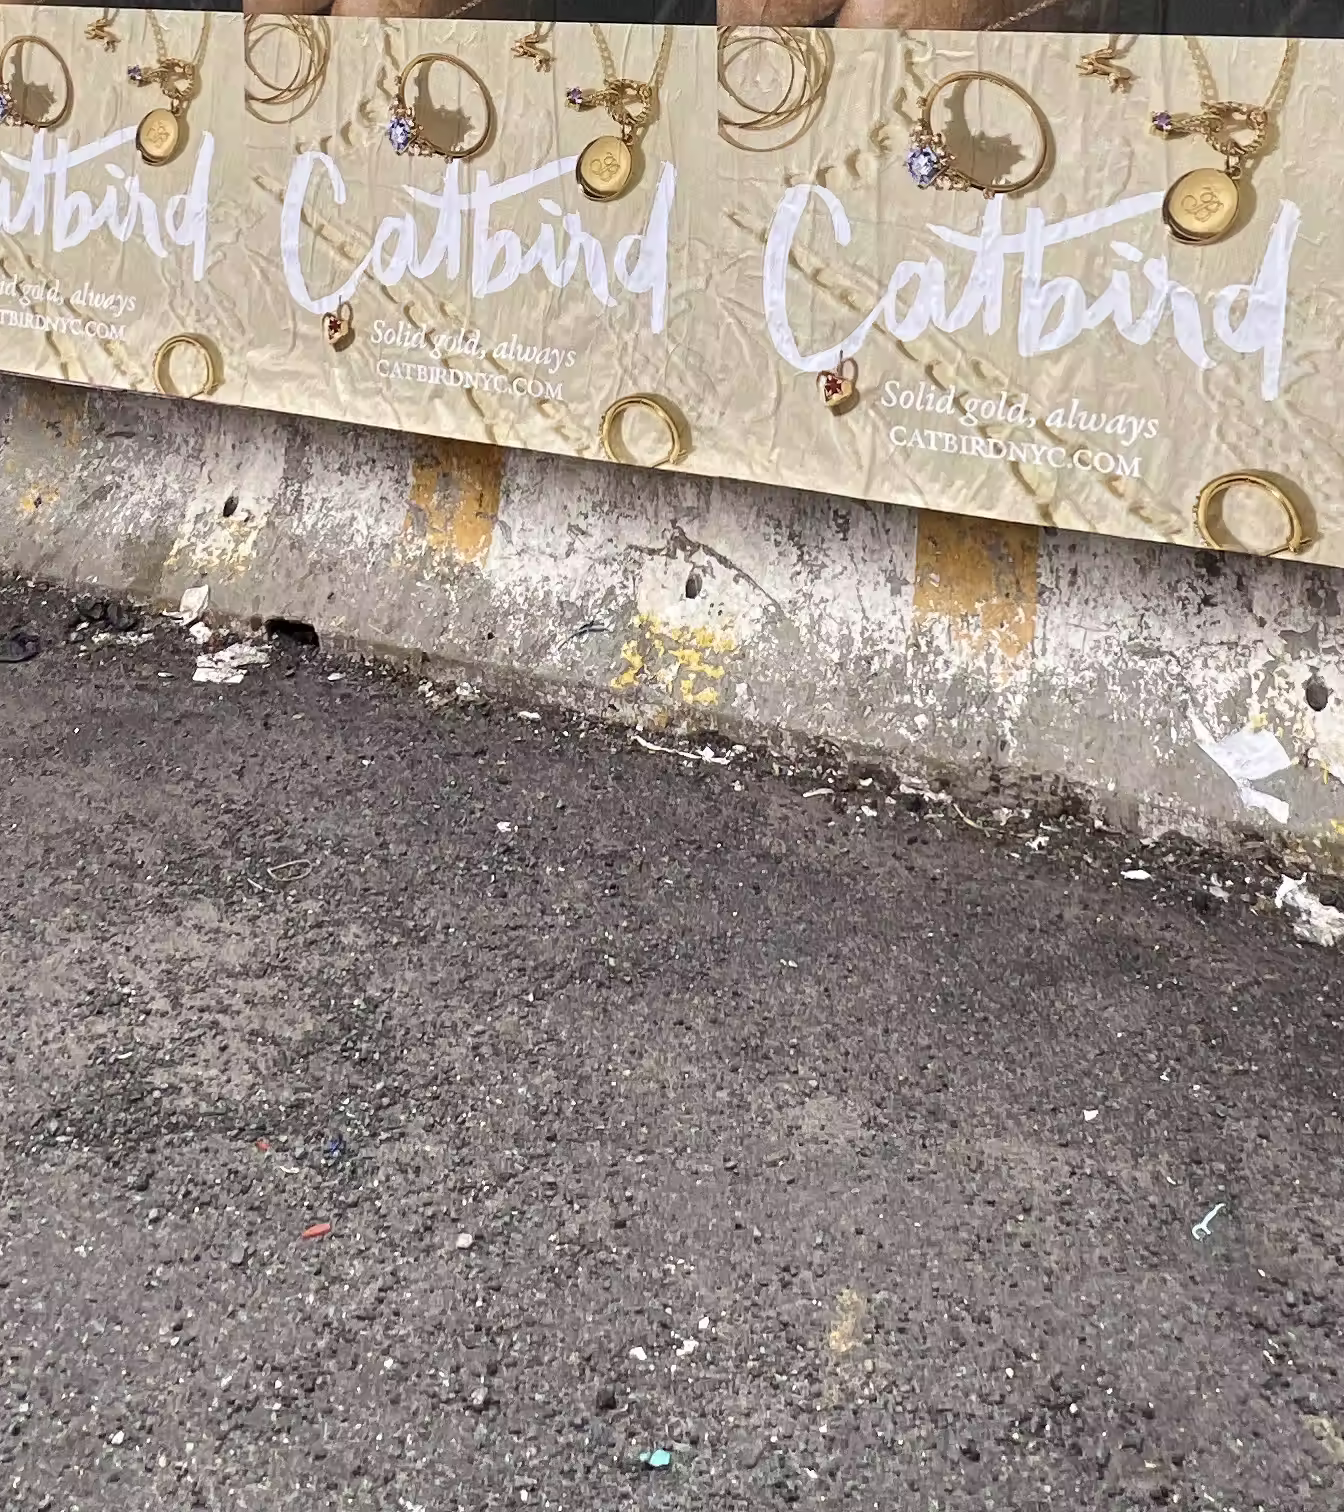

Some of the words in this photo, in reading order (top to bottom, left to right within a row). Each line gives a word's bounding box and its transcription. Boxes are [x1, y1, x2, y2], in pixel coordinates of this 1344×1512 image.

[281, 150, 676, 334] Catbird
[18, 279, 65, 306] gold,
[69, 282, 137, 318] always
[763, 184, 1301, 402] Catbird
[370, 319, 427, 349] Solid
[429, 327, 486, 360] gold,
[492, 333, 577, 374] always
[376, 359, 564, 401] CATBIRDNYC.COM
[880, 380, 956, 415] Solid
[959, 390, 1037, 428] gold,
[1045, 398, 1160, 447] always
[889, 425, 1143, 479] CATBIRDNYC.COM
